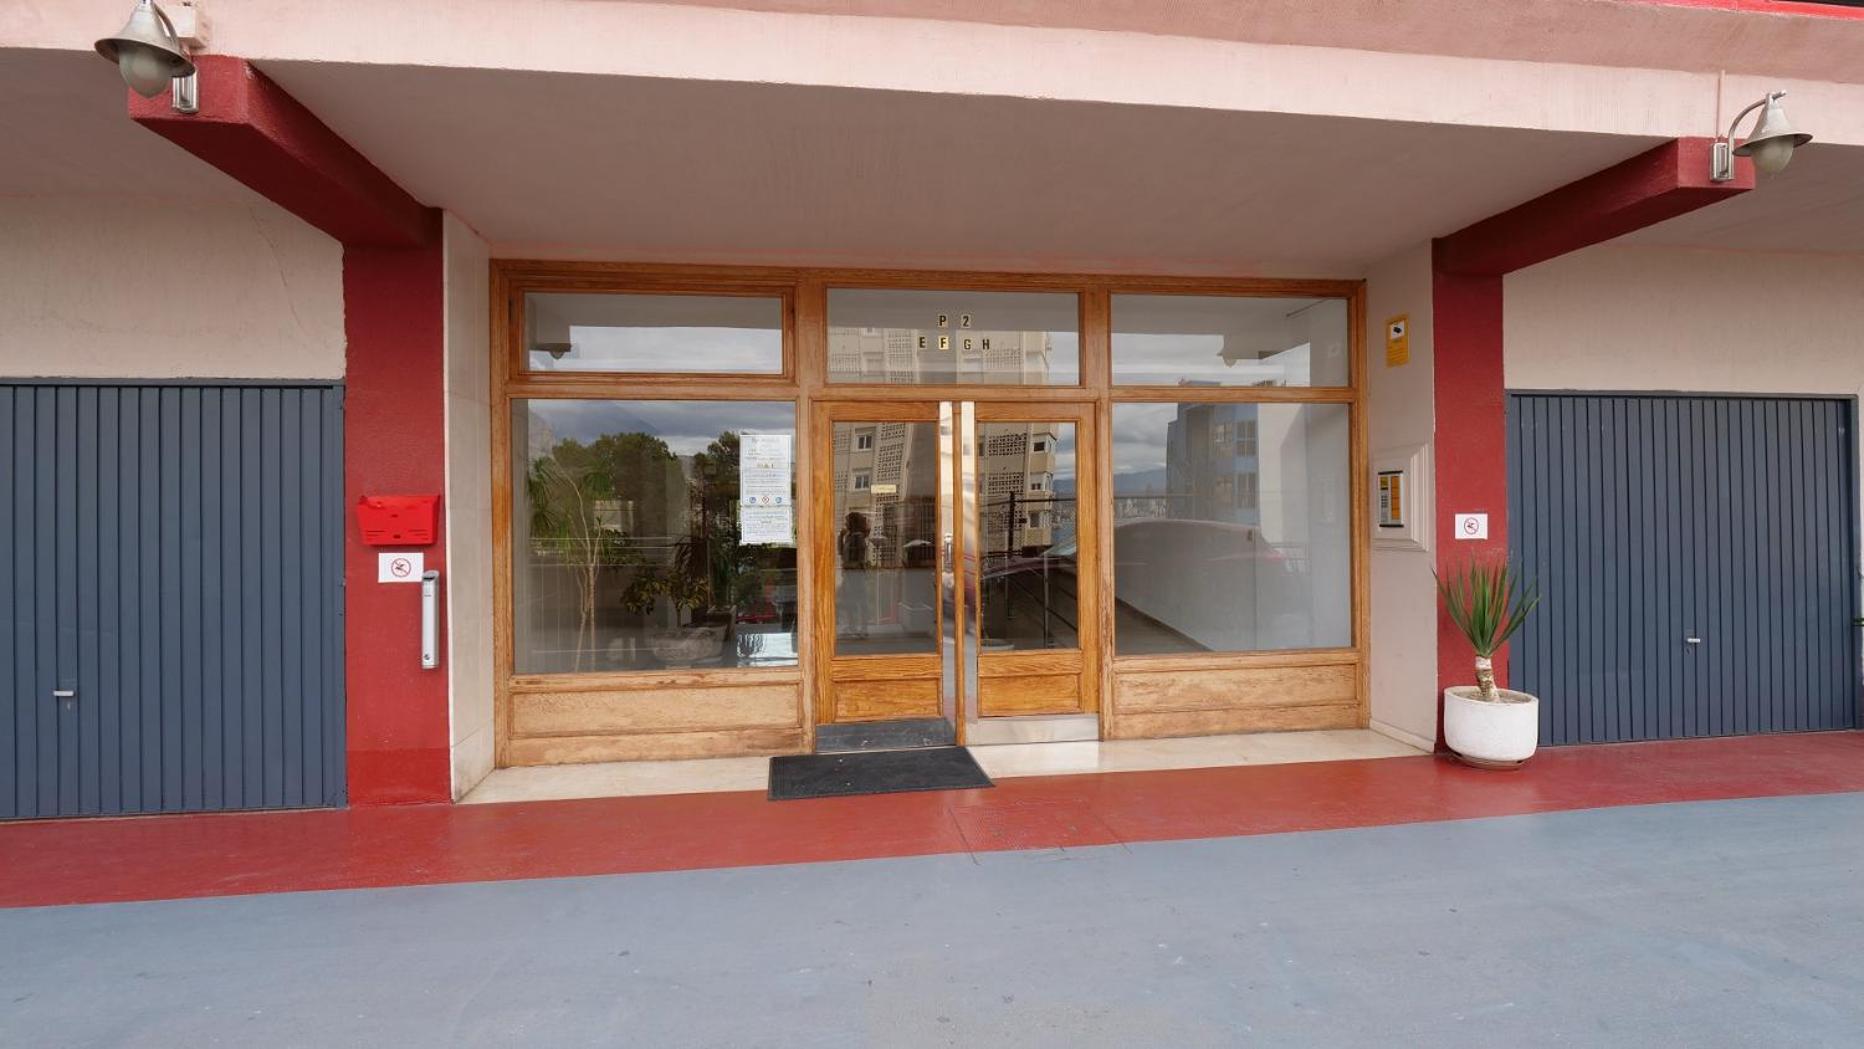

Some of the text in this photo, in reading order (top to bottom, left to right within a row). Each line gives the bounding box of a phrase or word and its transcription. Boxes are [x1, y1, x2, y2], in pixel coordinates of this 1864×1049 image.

[940, 315, 969, 327] P 2
[919, 337, 990, 350] E F G H
